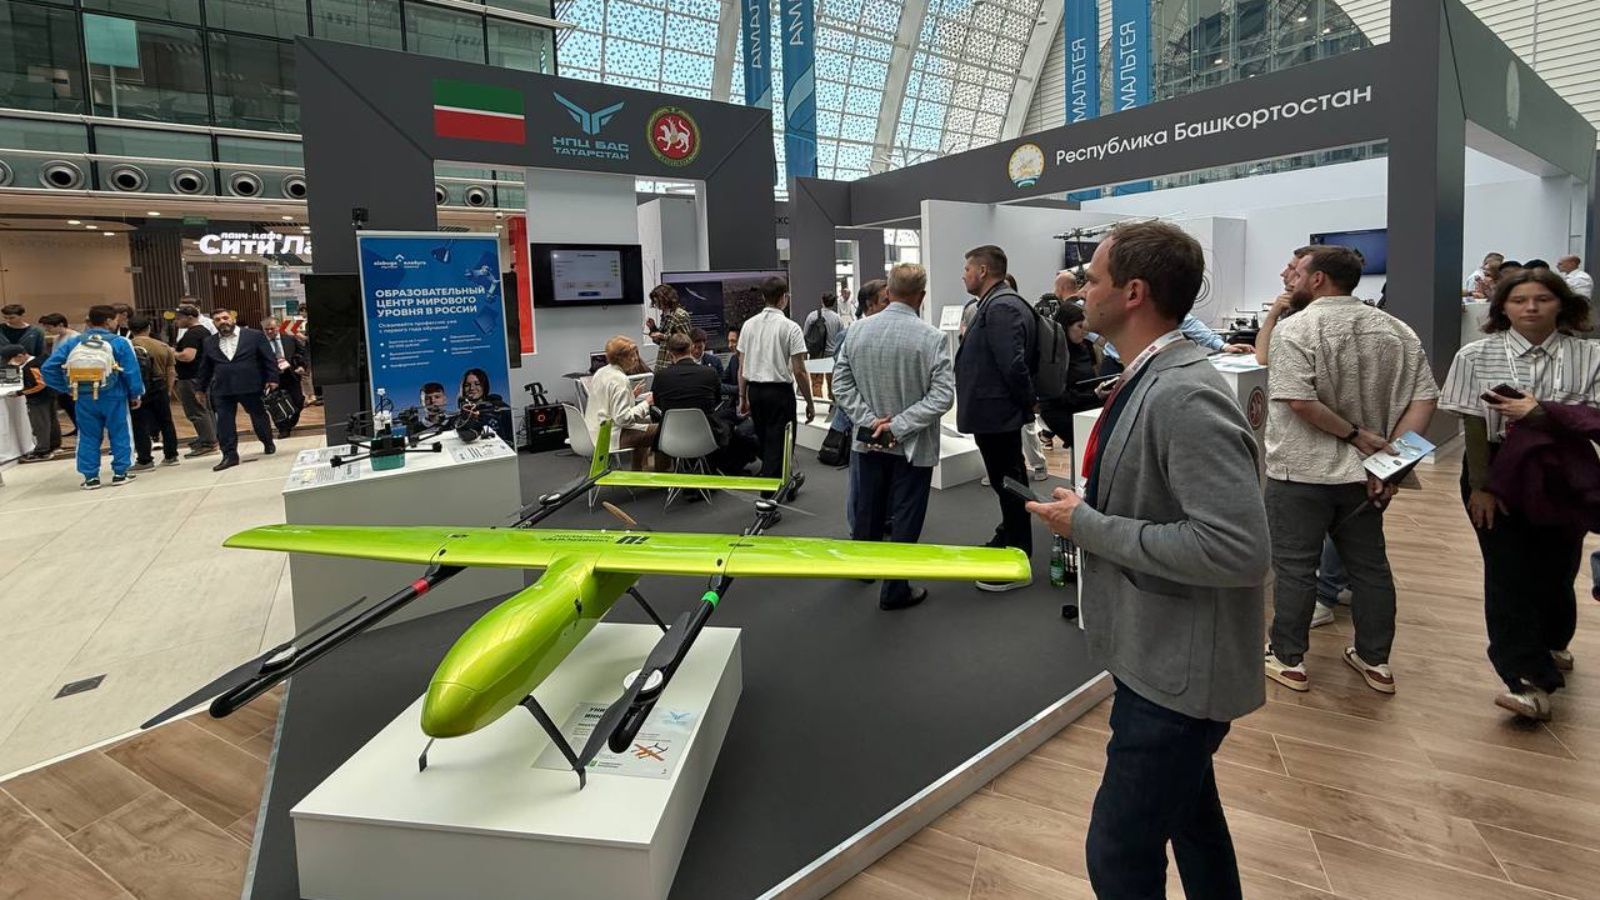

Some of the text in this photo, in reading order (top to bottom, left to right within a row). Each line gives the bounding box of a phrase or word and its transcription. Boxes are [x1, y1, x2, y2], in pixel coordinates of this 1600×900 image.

[787, 0, 804, 46] АМ
[1120, 20, 1137, 111] МАЛЬТЕЯ
[1072, 37, 1087, 123] МАЛЬТЕЯ
[1056, 85, 1372, 165] Республика Башкортостан
[552, 136, 630, 152] НПЦ БАС
[553, 147, 630, 160] ТАТАРСТАН
[220, 230, 284, 241] ланч-кафе
[199, 234, 276, 255] Сити
[375, 286, 485, 297] ОБРАЗОВАТЕЛЬНЫЙ
[376, 296, 476, 309] ЦЕНТР МИРОВОГО
[377, 305, 477, 318] УРОВНЯ В РОССИИ
